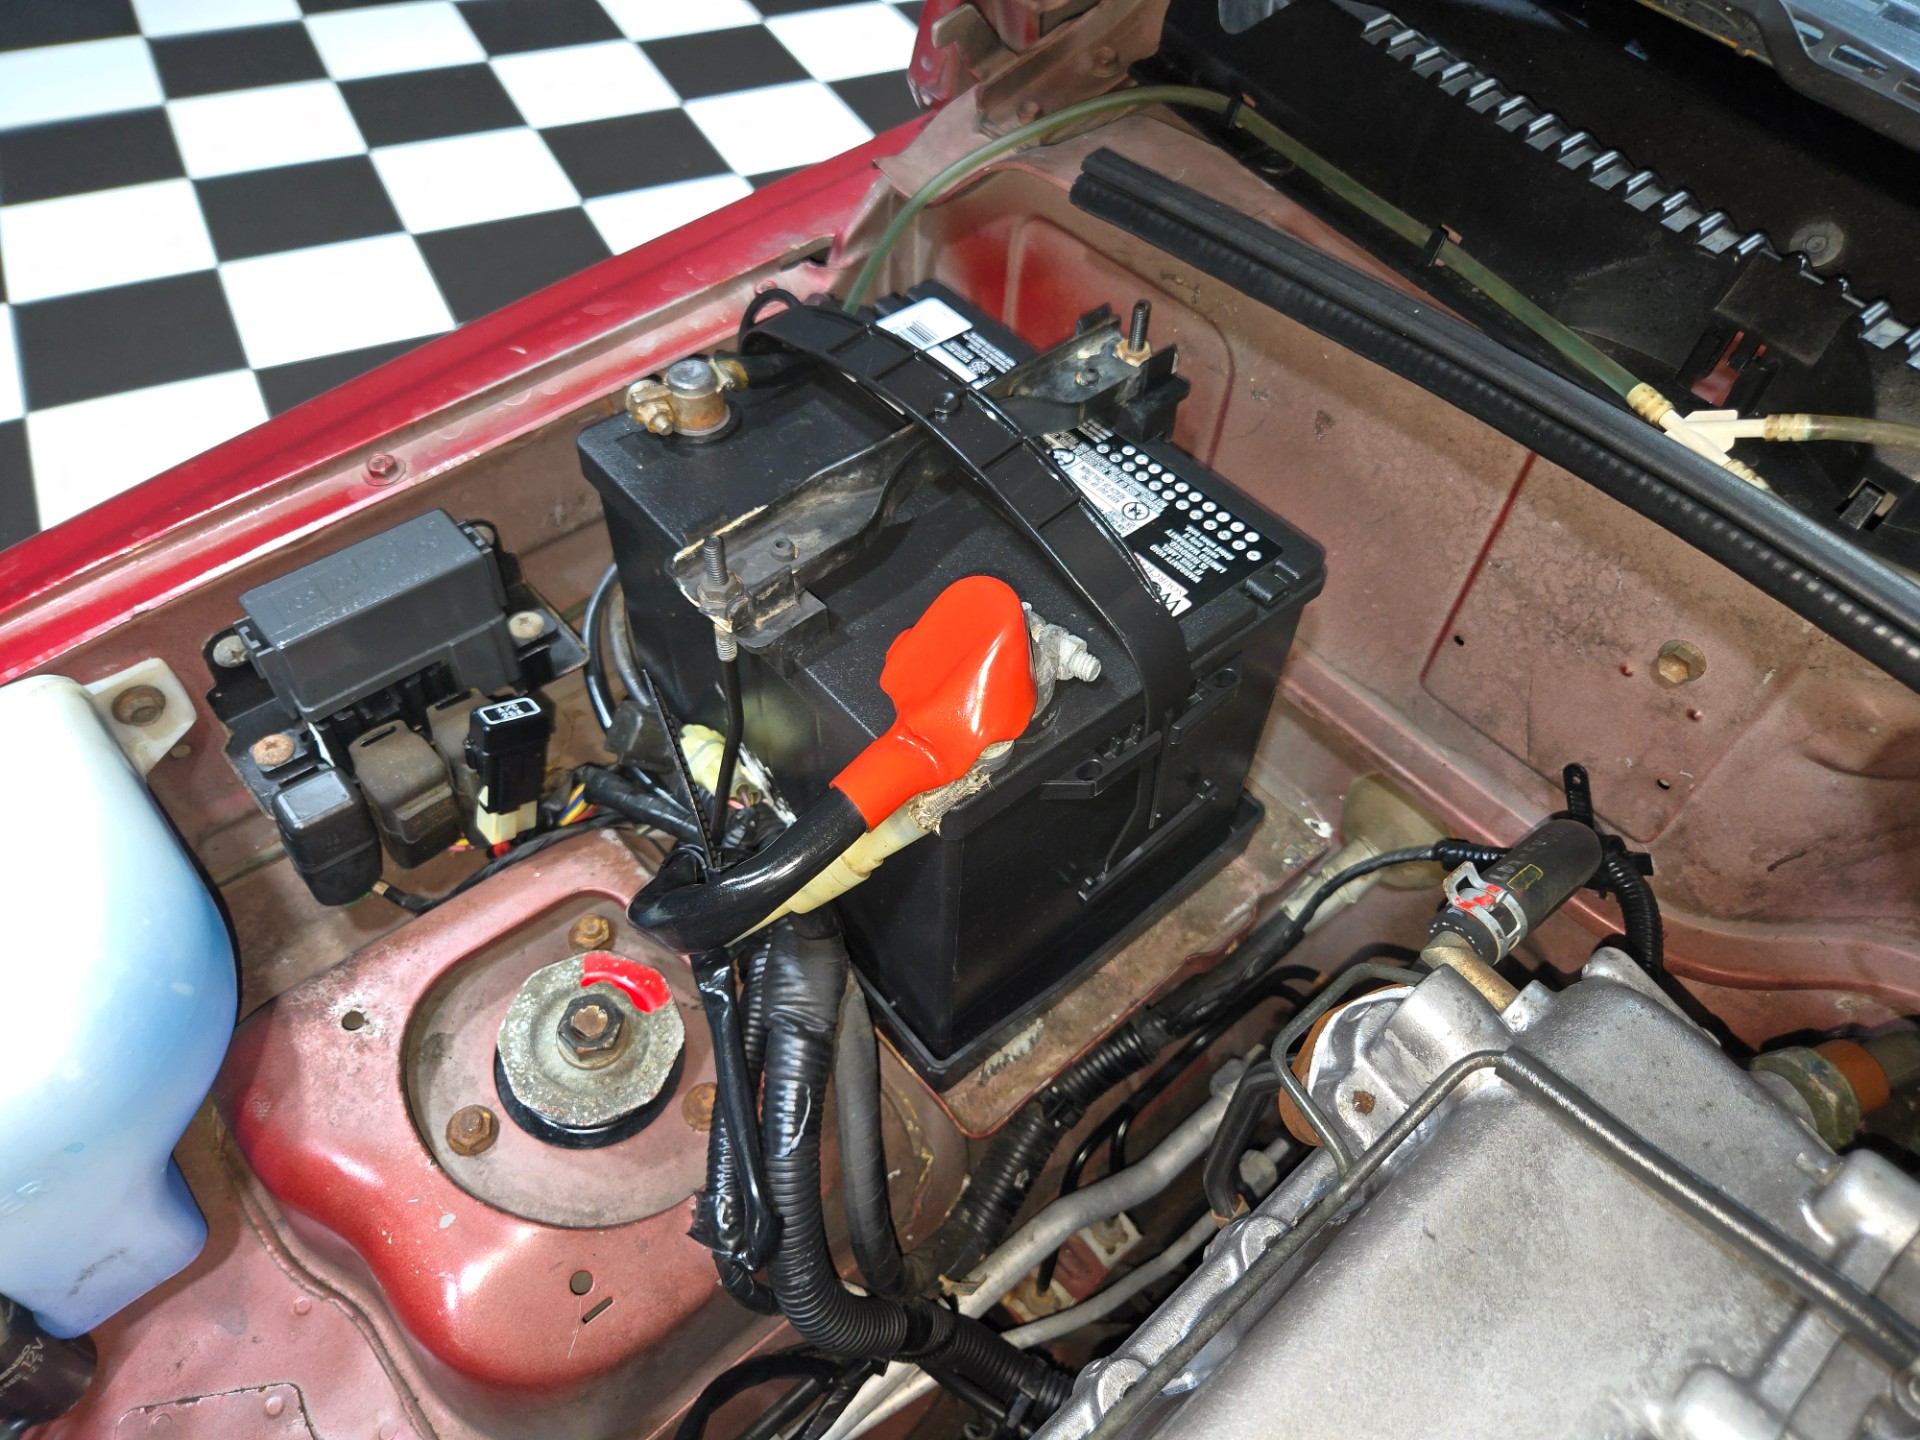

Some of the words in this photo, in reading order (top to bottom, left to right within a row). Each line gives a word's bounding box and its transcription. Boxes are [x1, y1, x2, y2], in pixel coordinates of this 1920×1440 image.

[1162, 526, 1203, 555] WARRANTY
[1187, 534, 1206, 548] only
[1197, 533, 1219, 549] when
[1147, 542, 1169, 559] VOID
[1159, 542, 1184, 560] LABEL
[1200, 545, 1221, 560] valid
[1212, 544, 1236, 562] dated
[1161, 554, 1203, 583] WARRANTY
[1178, 556, 1198, 570] THIS
[1192, 566, 1205, 576] IF
[1197, 551, 1228, 574] LIMITED
[1197, 561, 1209, 570] IS
[20, 1336, 45, 1369] 12V
